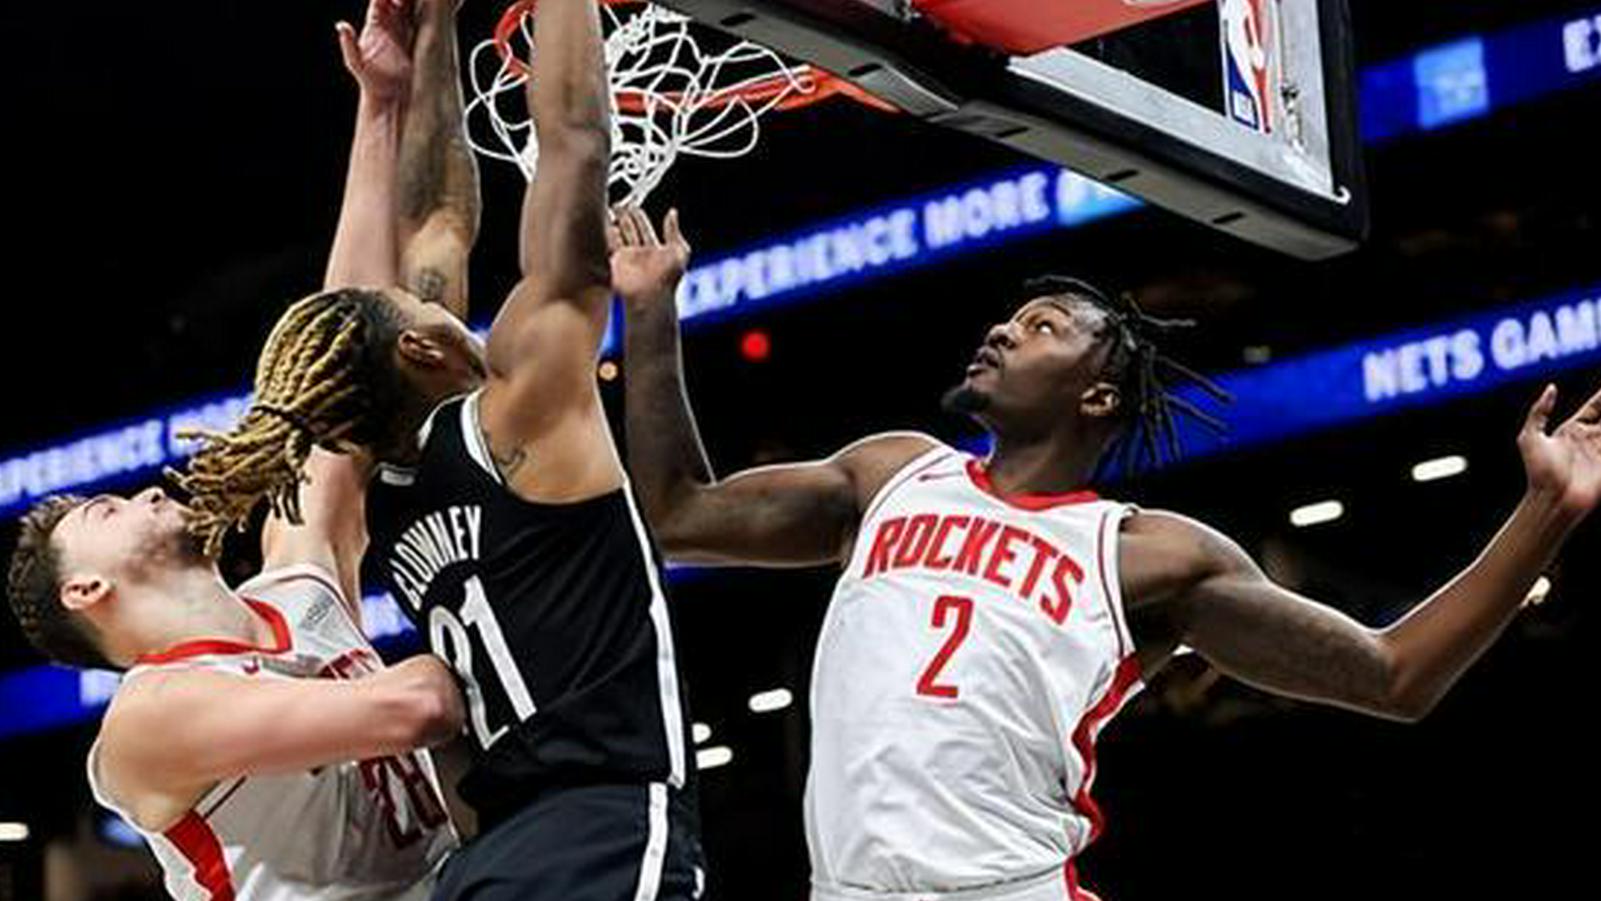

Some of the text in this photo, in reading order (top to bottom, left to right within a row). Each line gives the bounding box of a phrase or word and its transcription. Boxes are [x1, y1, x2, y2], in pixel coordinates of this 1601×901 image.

[676, 172, 1050, 320] EXPERIENCE MORE
[1363, 297, 1601, 402] NETS GAM
[389, 505, 482, 611] CLOWNEY
[862, 514, 1085, 626] ROCKETS
[430, 574, 537, 750] 21
[916, 595, 974, 698] 2
